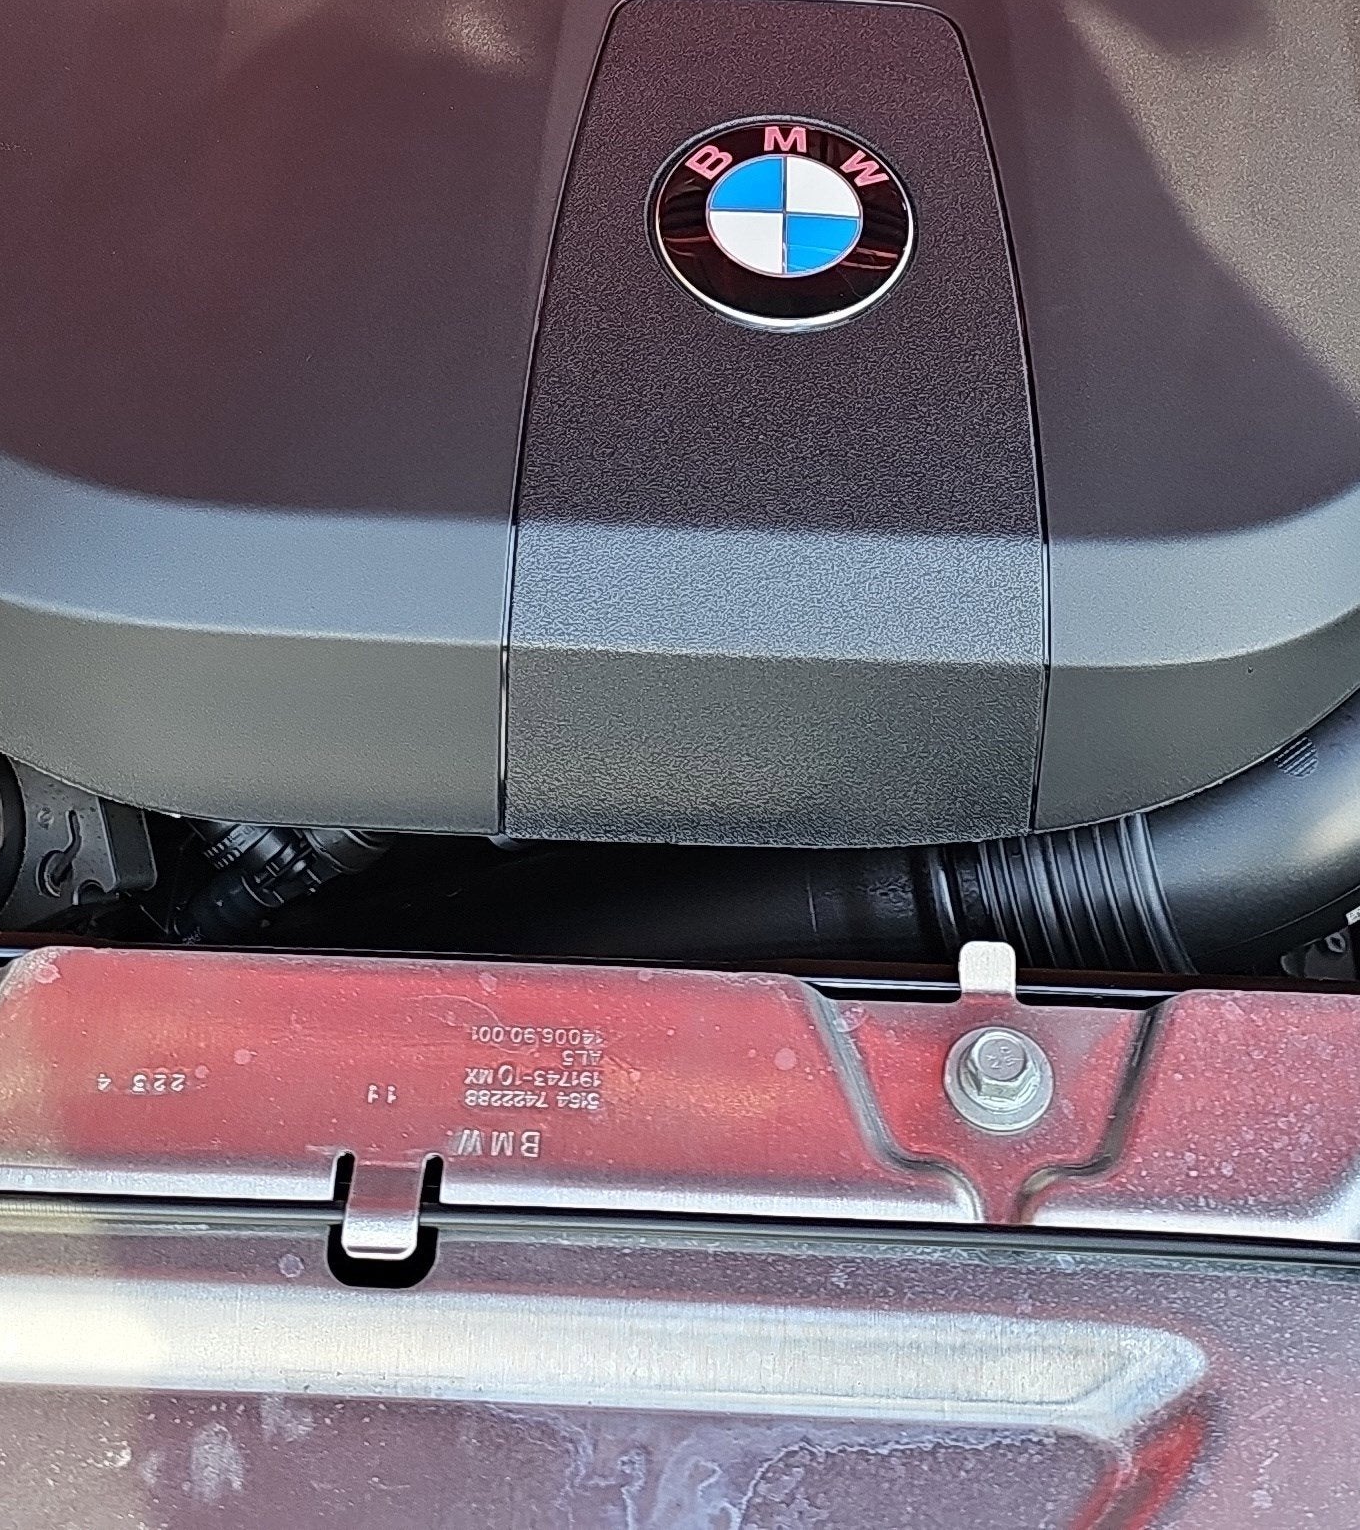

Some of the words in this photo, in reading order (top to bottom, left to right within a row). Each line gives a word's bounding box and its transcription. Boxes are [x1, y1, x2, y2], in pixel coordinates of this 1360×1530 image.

[684, 125, 890, 188] BMW
[498, 1064, 602, 1088] 191743-10
[464, 1088, 549, 1109] 7422288
[455, 1128, 541, 1158] BMW
